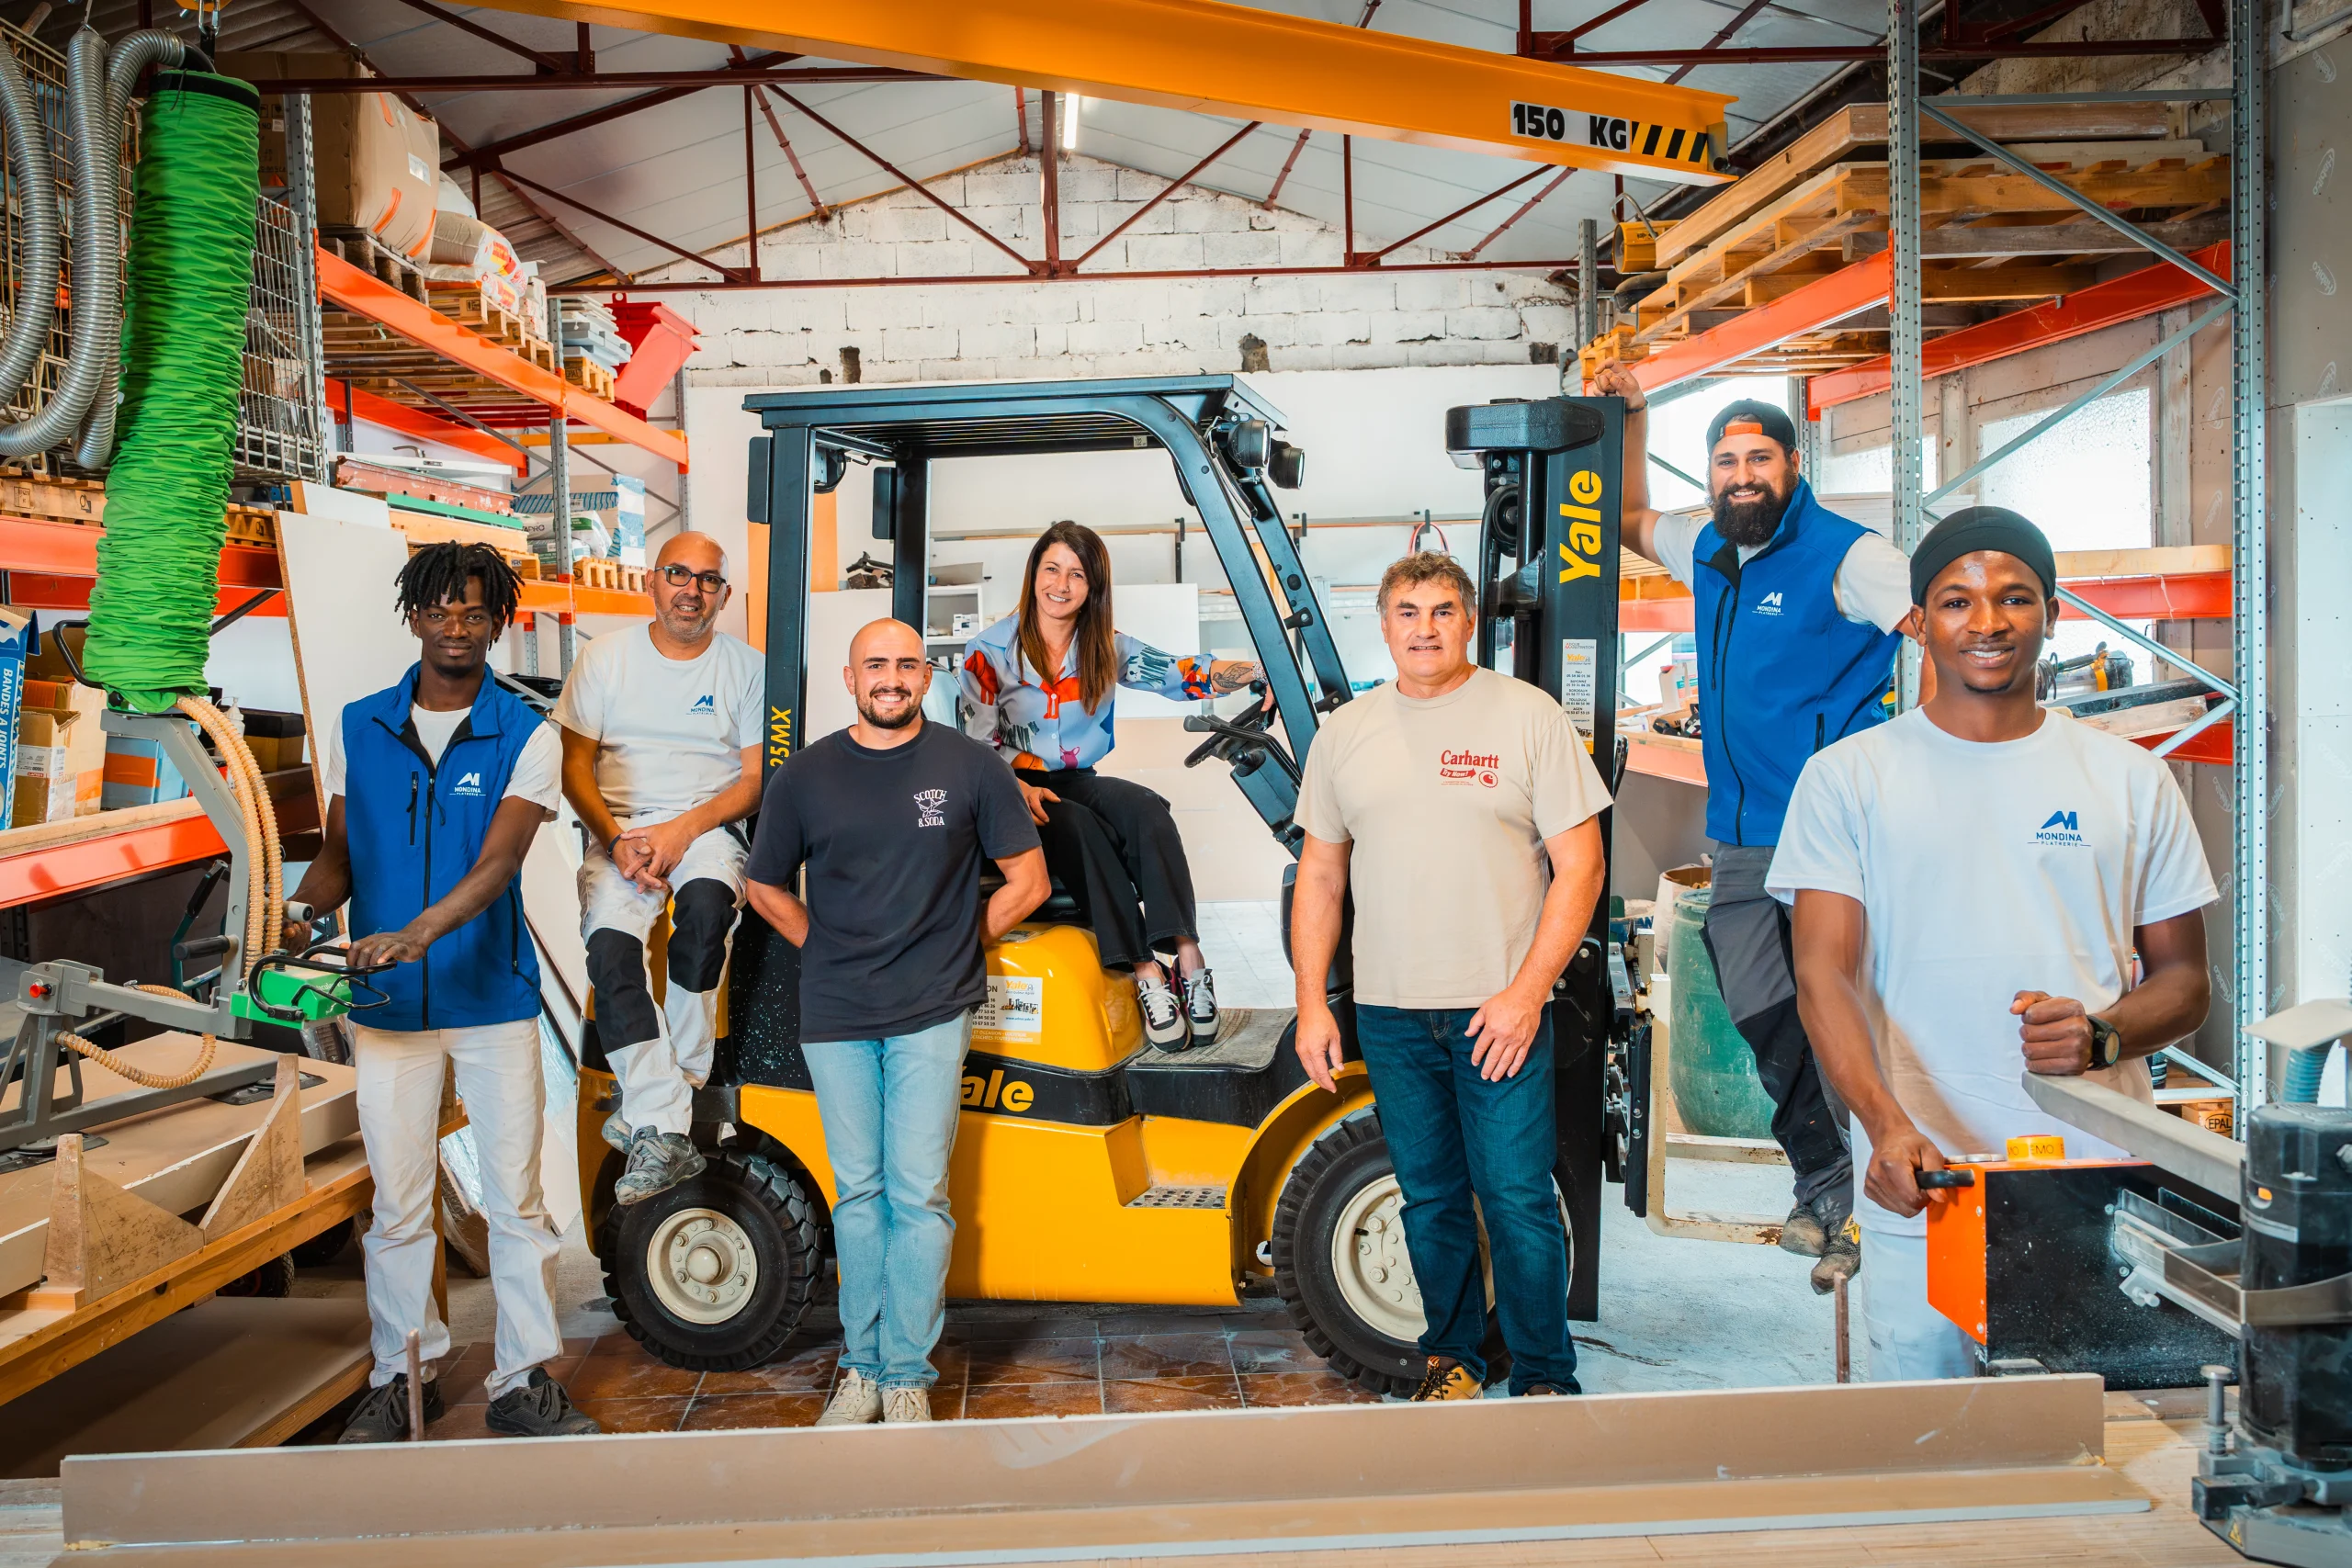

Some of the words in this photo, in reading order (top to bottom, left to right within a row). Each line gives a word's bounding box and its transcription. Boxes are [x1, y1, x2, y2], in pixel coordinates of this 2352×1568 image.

[1513, 104, 1565, 140] 150
[1589, 115, 1627, 150] KG
[1559, 470, 1602, 583] Yale
[1566, 653, 1586, 661] Yale
[1, 668, 13, 716] BANDES
[1441, 750, 1499, 769] Carhartt
[913, 789, 948, 802] SCOTCH
[925, 817, 945, 826] SODA
[2036, 832, 2082, 841] MONDINA
[1006, 980, 1028, 990] Yale
[960, 1066, 1035, 1112] ale
[2209, 1118, 2232, 1129] EPAL
[2030, 1145, 2054, 1154] EMO
